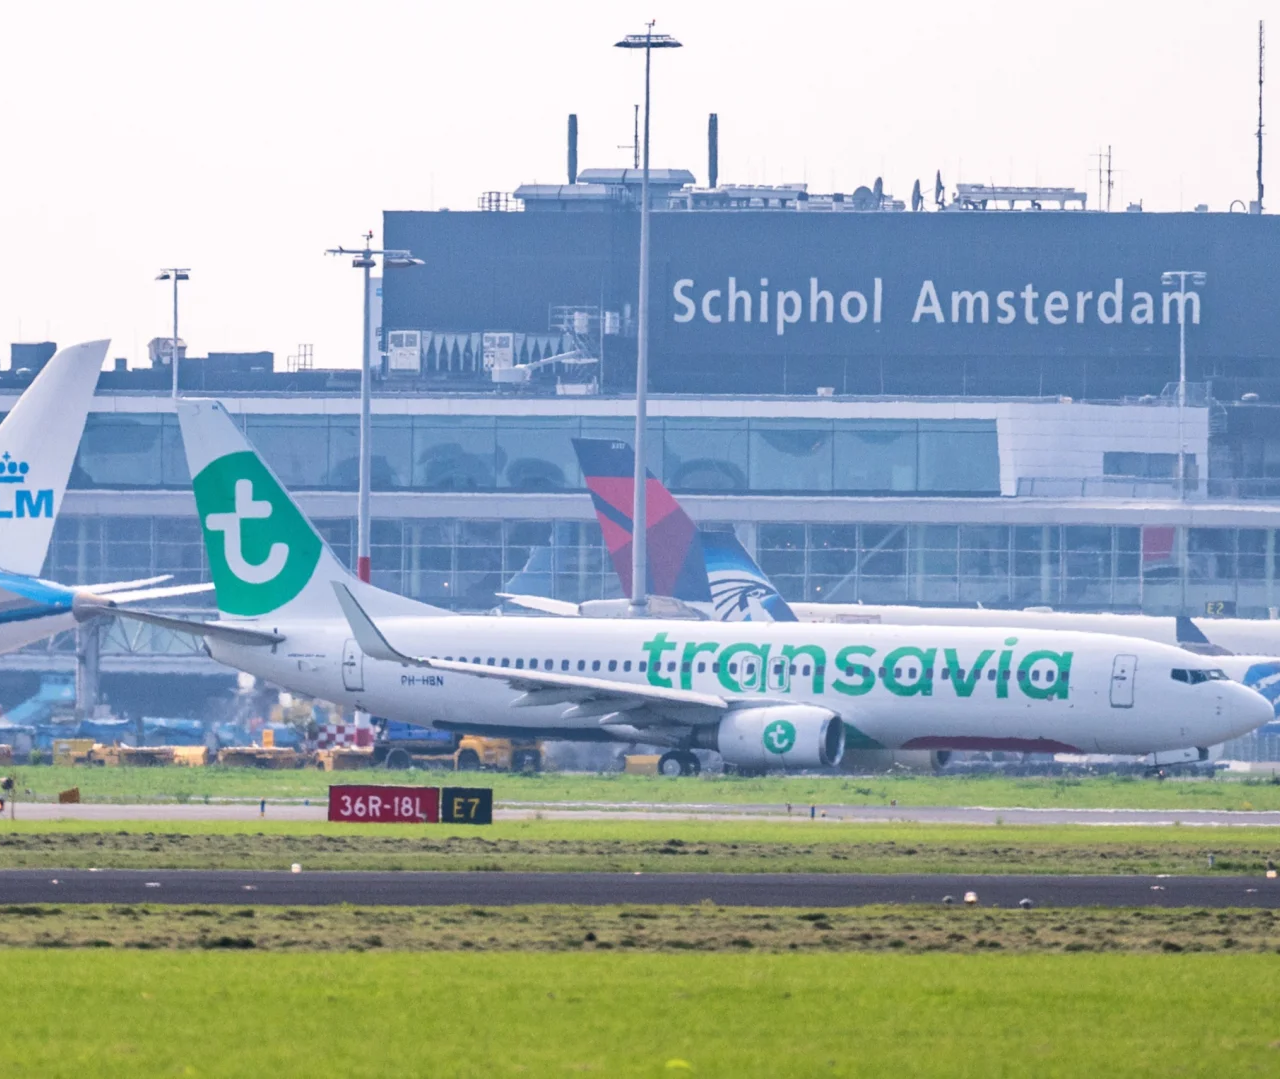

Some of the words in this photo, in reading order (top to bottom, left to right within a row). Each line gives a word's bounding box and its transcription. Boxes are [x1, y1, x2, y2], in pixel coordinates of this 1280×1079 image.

[673, 277, 882, 336] Schiphol
[911, 278, 1200, 325] Amsterdam
[1207, 602, 1225, 615] E2
[642, 631, 1074, 700] transavia
[400, 675, 444, 687] PH-HBN
[339, 795, 428, 817] 36R-18L
[452, 797, 481, 818] E7
